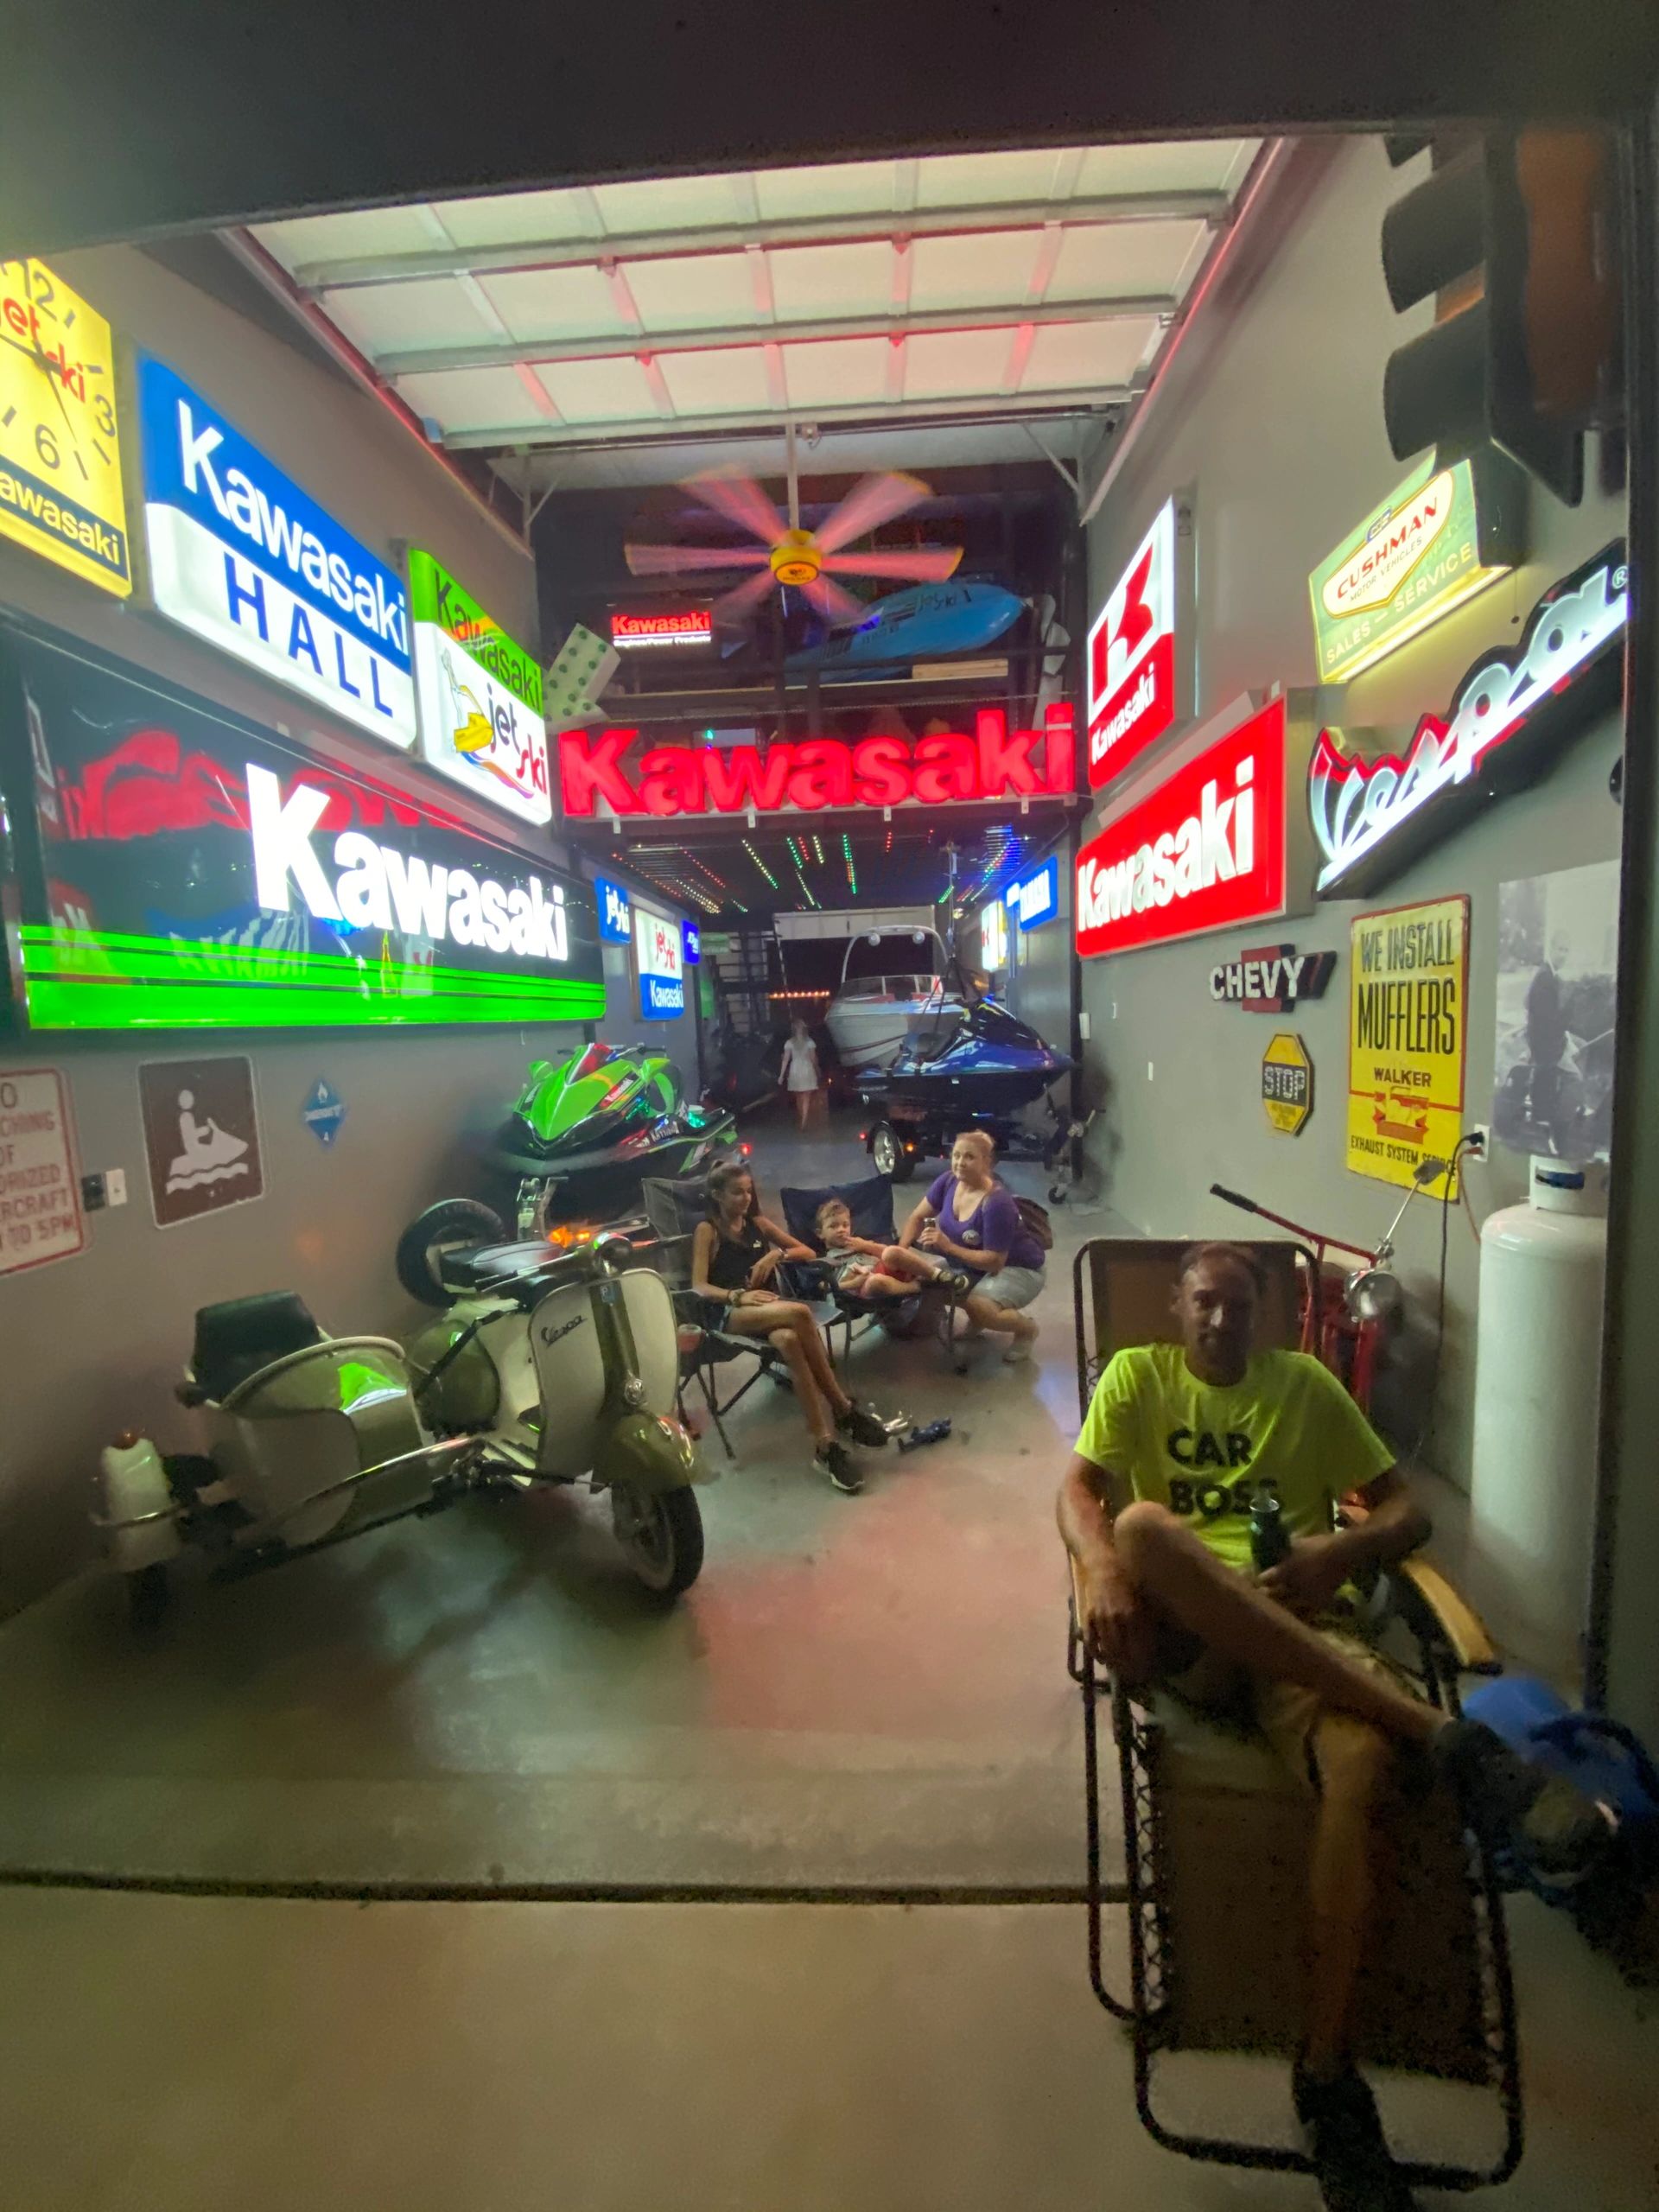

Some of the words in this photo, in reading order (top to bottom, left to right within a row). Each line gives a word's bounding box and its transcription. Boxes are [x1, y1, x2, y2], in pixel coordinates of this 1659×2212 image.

[0, 297, 41, 344] et
[92, 393, 117, 438] 3
[34, 423, 61, 470] 6
[0, 469, 120, 566] awasaki
[178, 397, 408, 656] Kawasaki
[1337, 497, 1438, 599] CUSHMAN
[1350, 576, 1376, 602] MOTOR
[1381, 536, 1423, 576] VEHICLES
[612, 610, 711, 635] Kawasaki
[1326, 621, 1371, 664] SALES
[1394, 542, 1472, 613] SERVICE
[224, 551, 393, 718] HALL
[435, 568, 542, 709] Kawasaki
[1091, 663, 1156, 766] Kawasaki
[559, 703, 1075, 817] Kawasaki
[245, 762, 569, 961] Kawasaki
[1077, 754, 1255, 931] Kawasaki
[1361, 931, 1382, 972] WE
[1387, 919, 1454, 971] INSTALL
[650, 979, 684, 1008] Kawasaki
[1210, 957, 1305, 1000] CHEVY
[1357, 977, 1455, 1055] MUFFLERS
[0, 1082, 17, 1109] O
[1263, 1065, 1306, 1101] STOP
[1373, 1067, 1432, 1087] WALKER
[1351, 1135, 1384, 1157] EXHAUST
[1387, 1143, 1419, 1165] SYSTEM
[540, 1315, 588, 1348] Vespa
[1167, 1427, 1252, 1467] CAR
